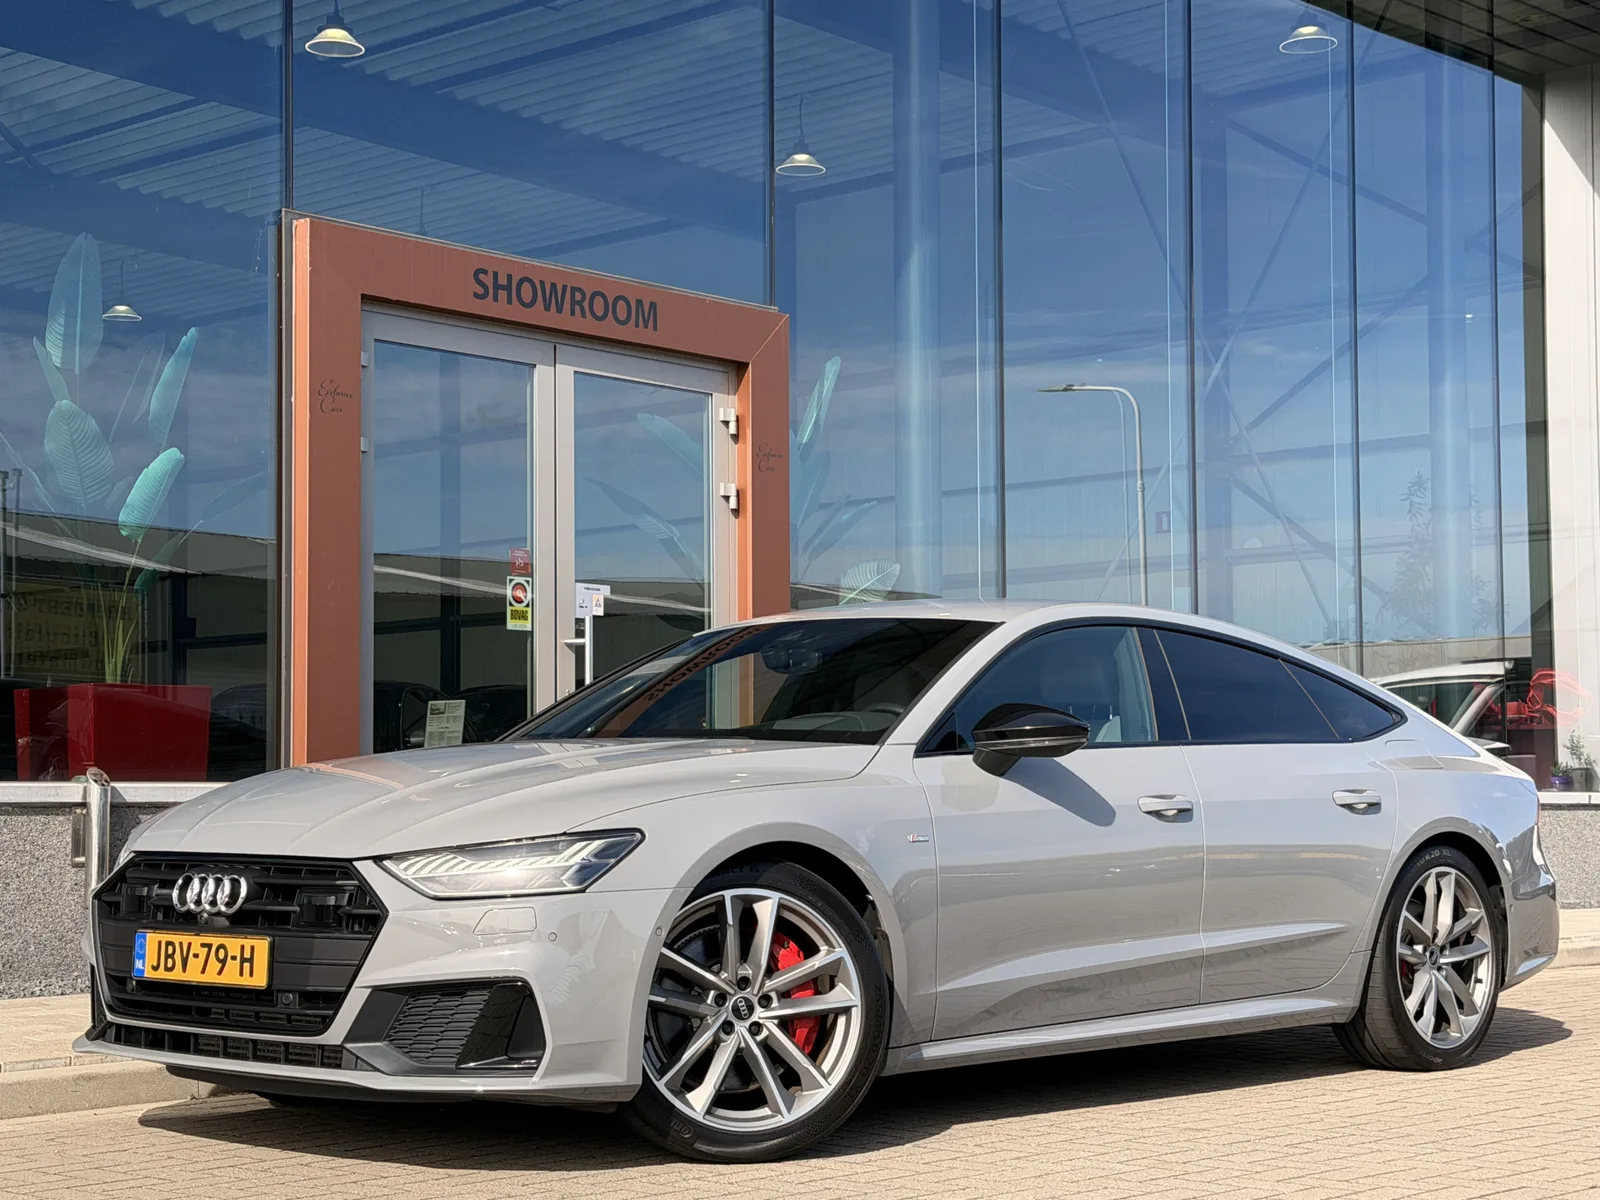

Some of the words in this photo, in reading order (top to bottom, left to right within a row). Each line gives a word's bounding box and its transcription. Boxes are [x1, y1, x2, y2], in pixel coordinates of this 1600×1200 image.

[472, 267, 659, 332] SHOWROOM
[510, 609, 529, 621] BOVAG
[135, 959, 145, 970] NL
[150, 939, 256, 979] JBV-79-H
